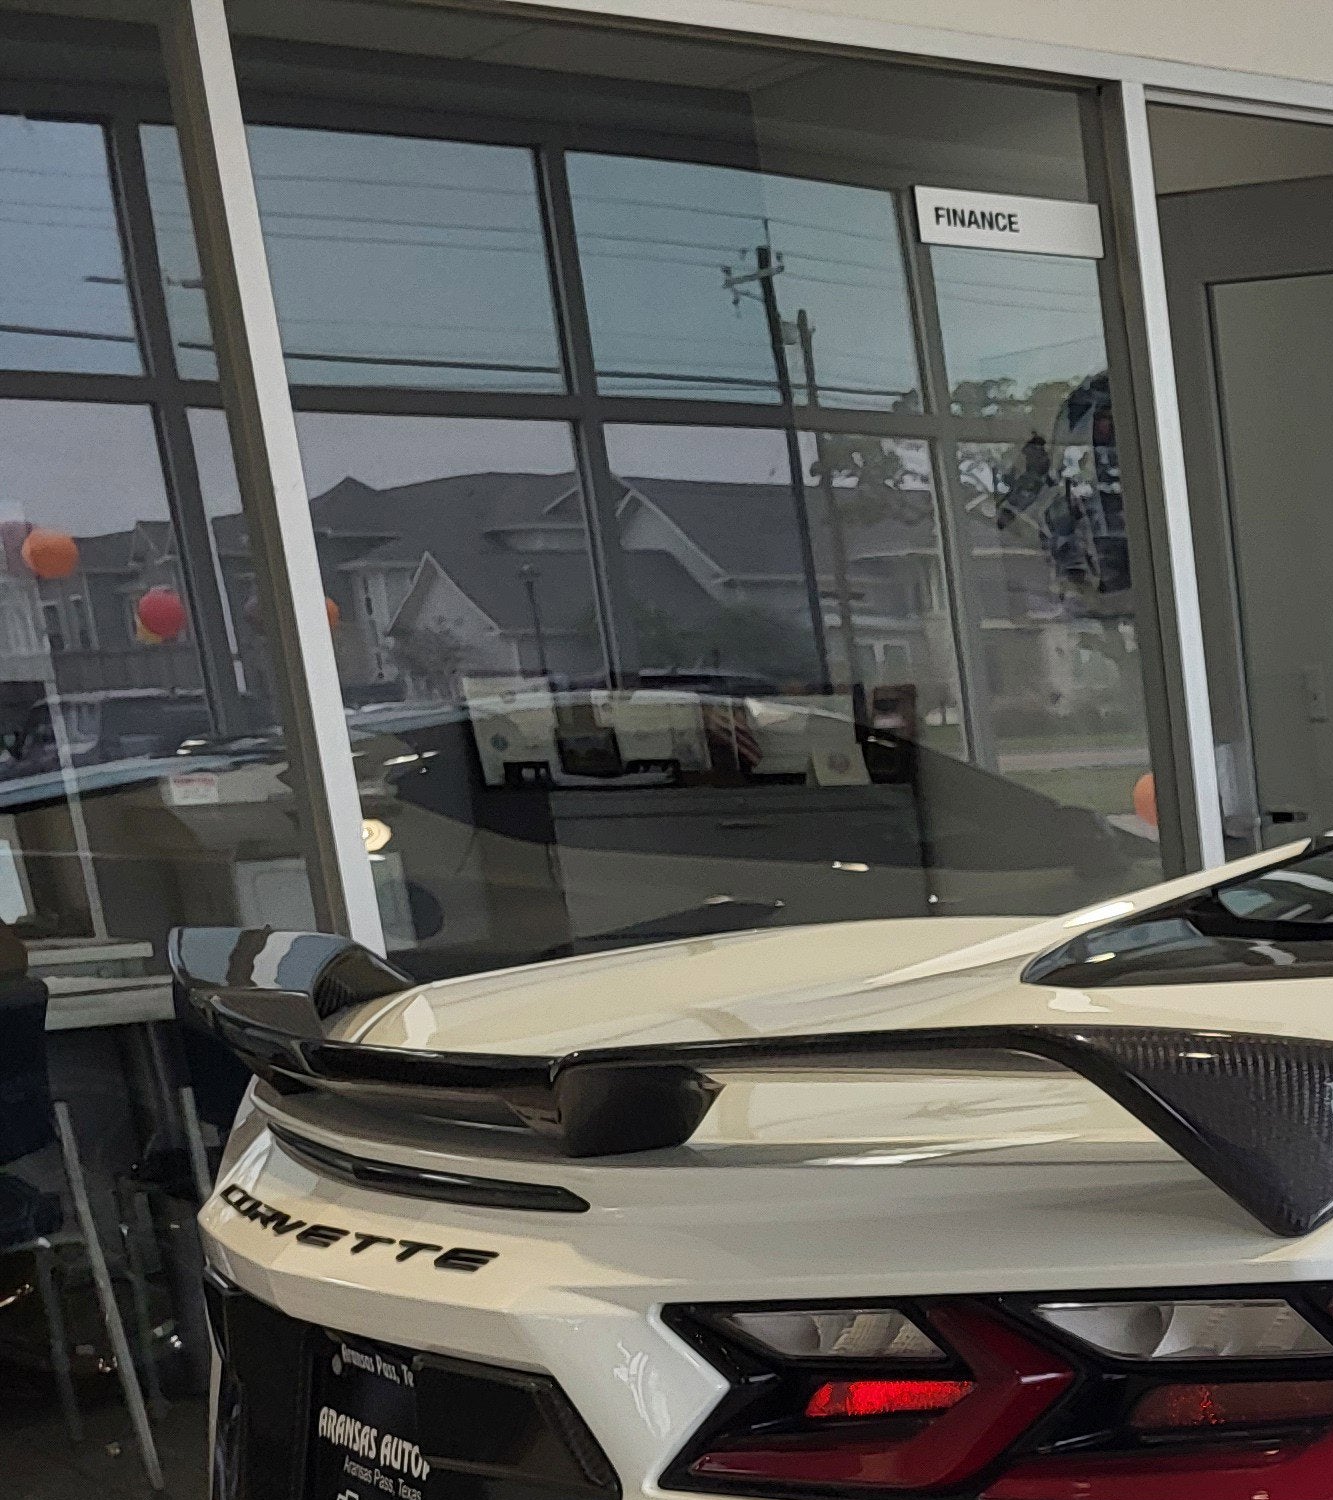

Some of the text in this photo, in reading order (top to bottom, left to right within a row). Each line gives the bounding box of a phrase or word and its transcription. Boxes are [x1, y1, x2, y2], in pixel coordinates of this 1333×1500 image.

[934, 206, 1020, 233] FINANCE
[219, 1183, 501, 1273] CORVETTE
[318, 1406, 378, 1460] ARANSAS
